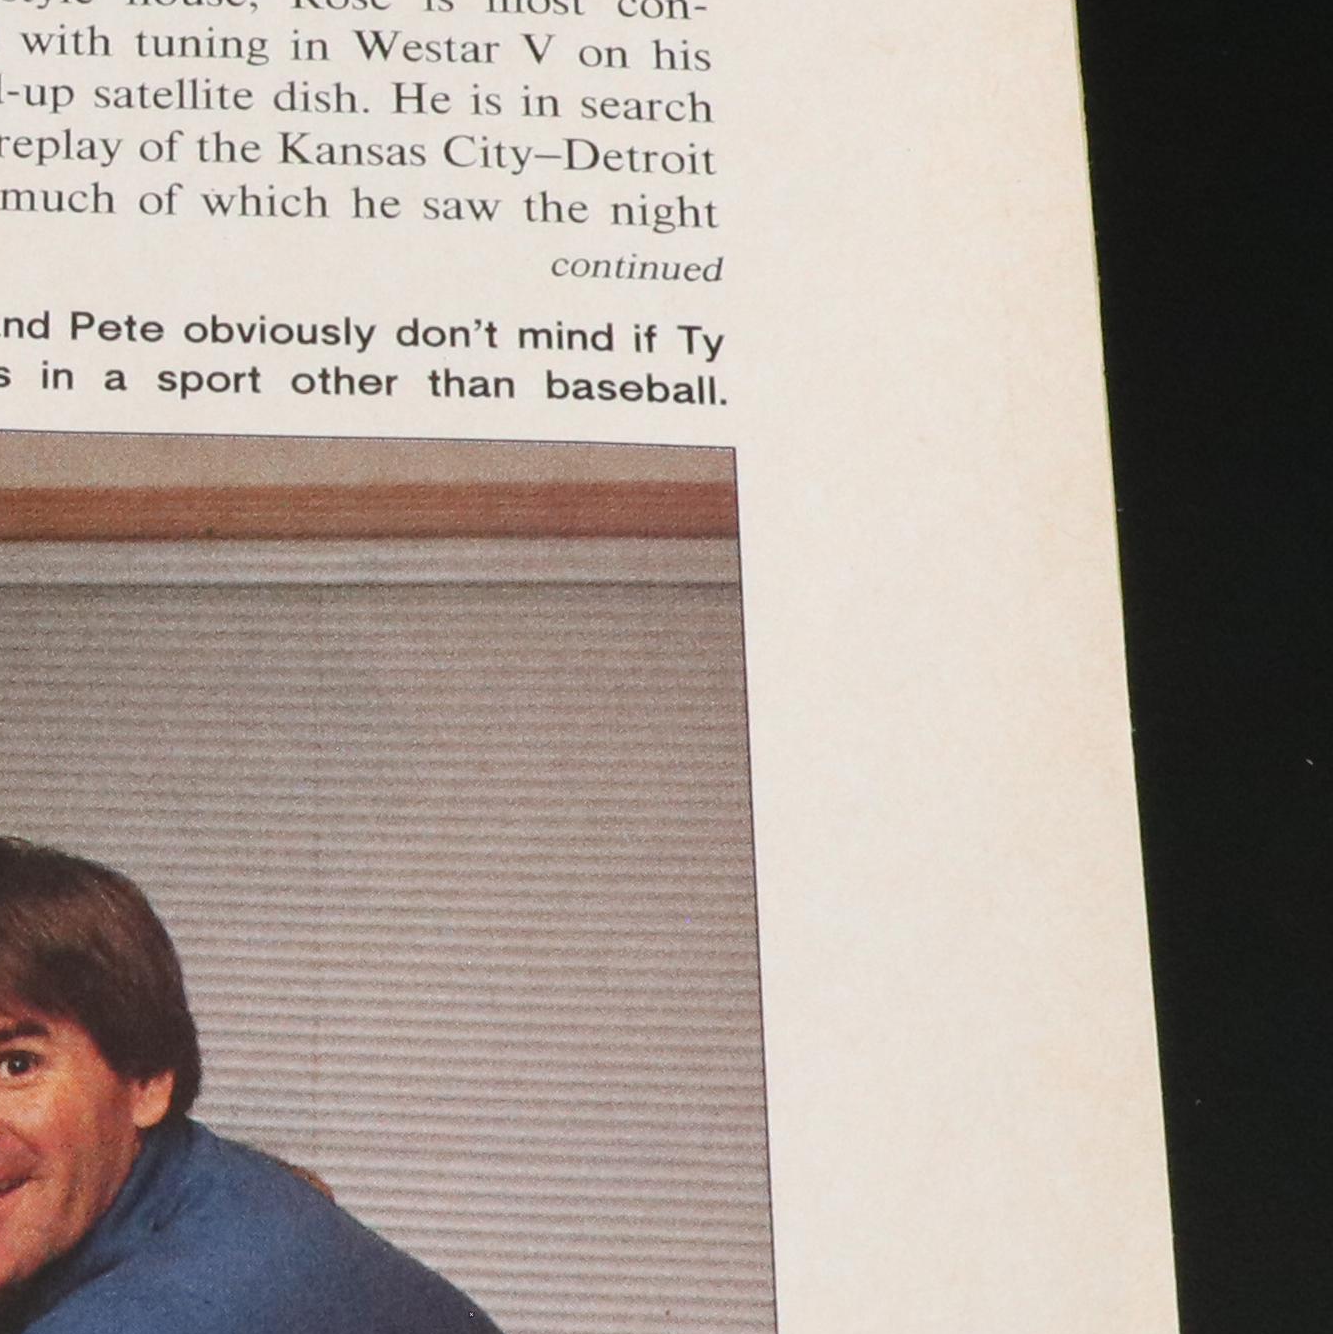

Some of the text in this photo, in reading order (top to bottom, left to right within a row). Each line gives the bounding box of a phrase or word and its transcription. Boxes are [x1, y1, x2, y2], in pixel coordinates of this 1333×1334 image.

[94, 77, 254, 111] satellite
[272, 80, 370, 114] dish.
[391, 81, 452, 115] He
[471, 83, 502, 116] is
[521, 84, 561, 118] in
[580, 90, 714, 124] search
[550, 253, 724, 283] continued
[70, 310, 165, 343] Pete
[183, 313, 377, 354] obviously
[395, 317, 499, 349] don't
[518, 320, 614, 353] mind
[633, 323, 658, 354] if
[676, 324, 726, 364] Ty
[41, 359, 74, 391] in
[103, 368, 128, 392] a
[156, 365, 262, 401] sport
[290, 365, 399, 397] other
[427, 367, 515, 399] than
[545, 368, 728, 406] baseball.
